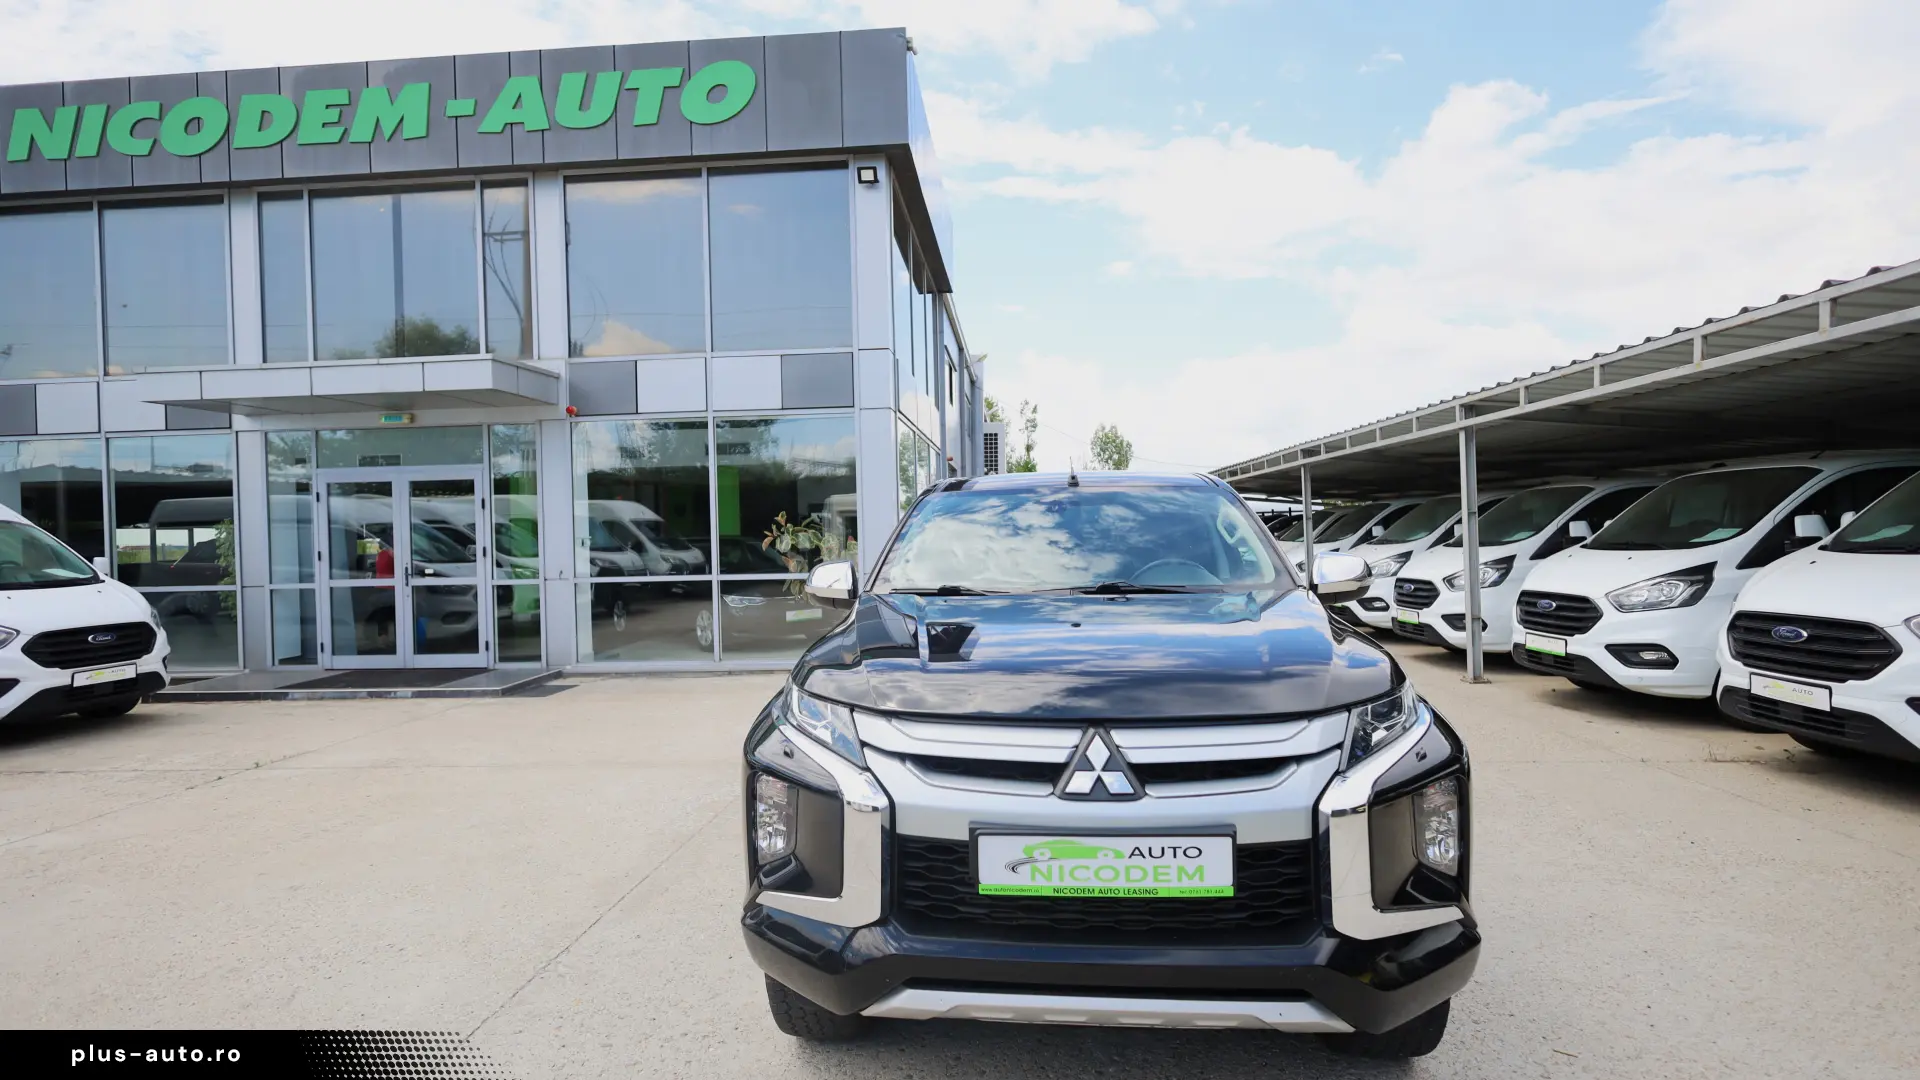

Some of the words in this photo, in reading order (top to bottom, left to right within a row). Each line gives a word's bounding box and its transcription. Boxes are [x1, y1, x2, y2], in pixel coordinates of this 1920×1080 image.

[1792, 687, 1813, 696] AUTO
[1128, 846, 1203, 859] AUTO
[1029, 863, 1206, 884] NICODEM
[1052, 887, 1096, 896] NICODEM
[1097, 888, 1121, 896] AUTO
[1122, 888, 1159, 896] LEASING
